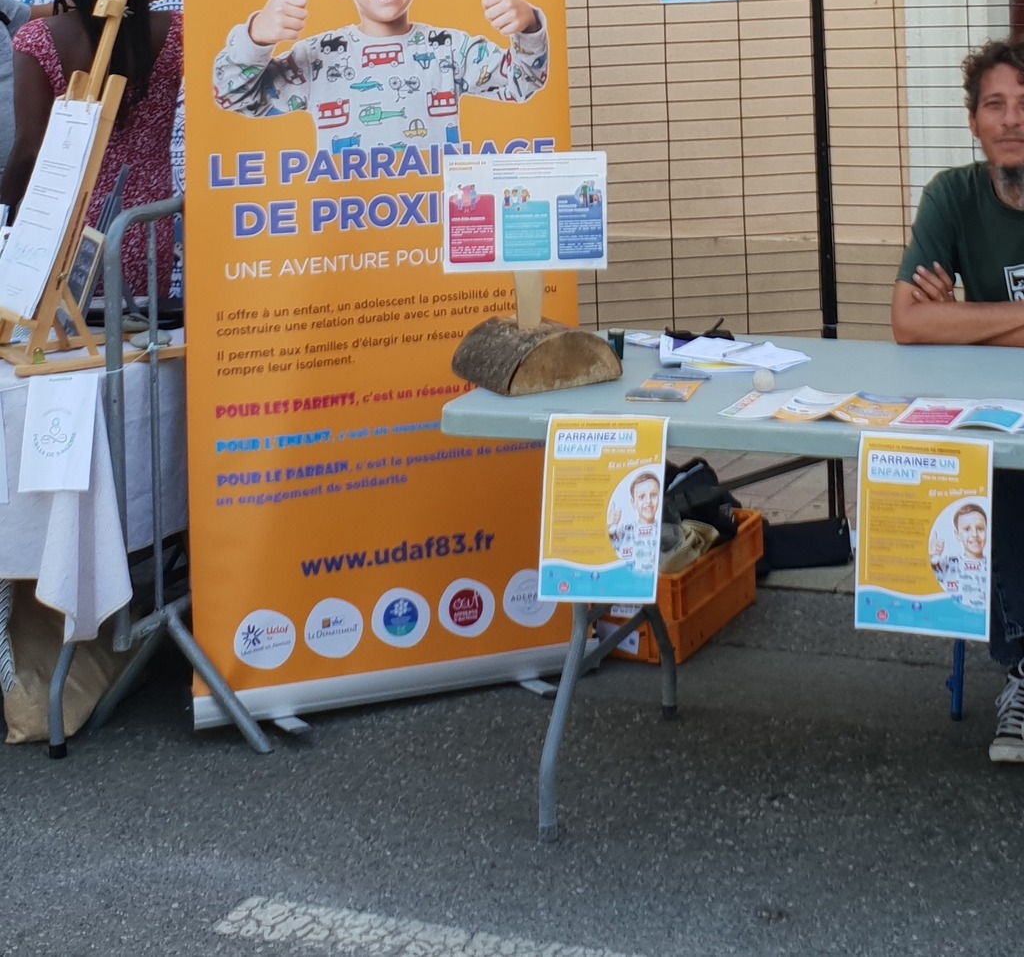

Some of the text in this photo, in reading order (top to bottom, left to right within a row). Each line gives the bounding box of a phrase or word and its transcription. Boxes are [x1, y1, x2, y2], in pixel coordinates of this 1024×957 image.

[209, 151, 266, 189] LE
[234, 190, 444, 238] DE PROXI
[224, 259, 272, 281] UNE
[279, 252, 389, 278] AVENTURE
[217, 311, 224, 322] Il
[228, 309, 258, 321] offre
[263, 308, 270, 318] à
[274, 308, 289, 317] un
[294, 303, 334, 315] enfant,
[337, 302, 350, 312] un
[354, 295, 415, 310] adolescent
[420, 293, 429, 304] la
[432, 288, 489, 305] possibilité
[493, 288, 506, 297] de
[216, 321, 281, 337] construire
[285, 321, 308, 332] une
[311, 316, 354, 329] relation
[358, 308, 400, 325] durable
[404, 310, 430, 320] avec
[433, 309, 447, 317] un
[450, 305, 479, 316] autre
[217, 328, 464, 362] Il permet aux familles d'élargir leur réseau
[217, 355, 356, 377] rompre leur isolement.
[216, 402, 260, 419] POUR
[265, 399, 289, 415] LES
[293, 392, 359, 412] PARENTS,
[362, 390, 393, 403] c'est
[397, 389, 413, 399] un
[416, 384, 459, 397] réseau
[216, 438, 262, 454] POUR
[557, 444, 598, 452] ENFANT
[558, 432, 633, 441] PARRAINEZ UN
[871, 454, 955, 469] PARRAINEZ UN
[871, 467, 918, 479] ENFANT
[217, 473, 262, 487] POUR
[266, 469, 283, 484] LE
[216, 496, 234, 507] un
[327, 483, 342, 493] de
[301, 529, 495, 578] www.udaf83.fr
